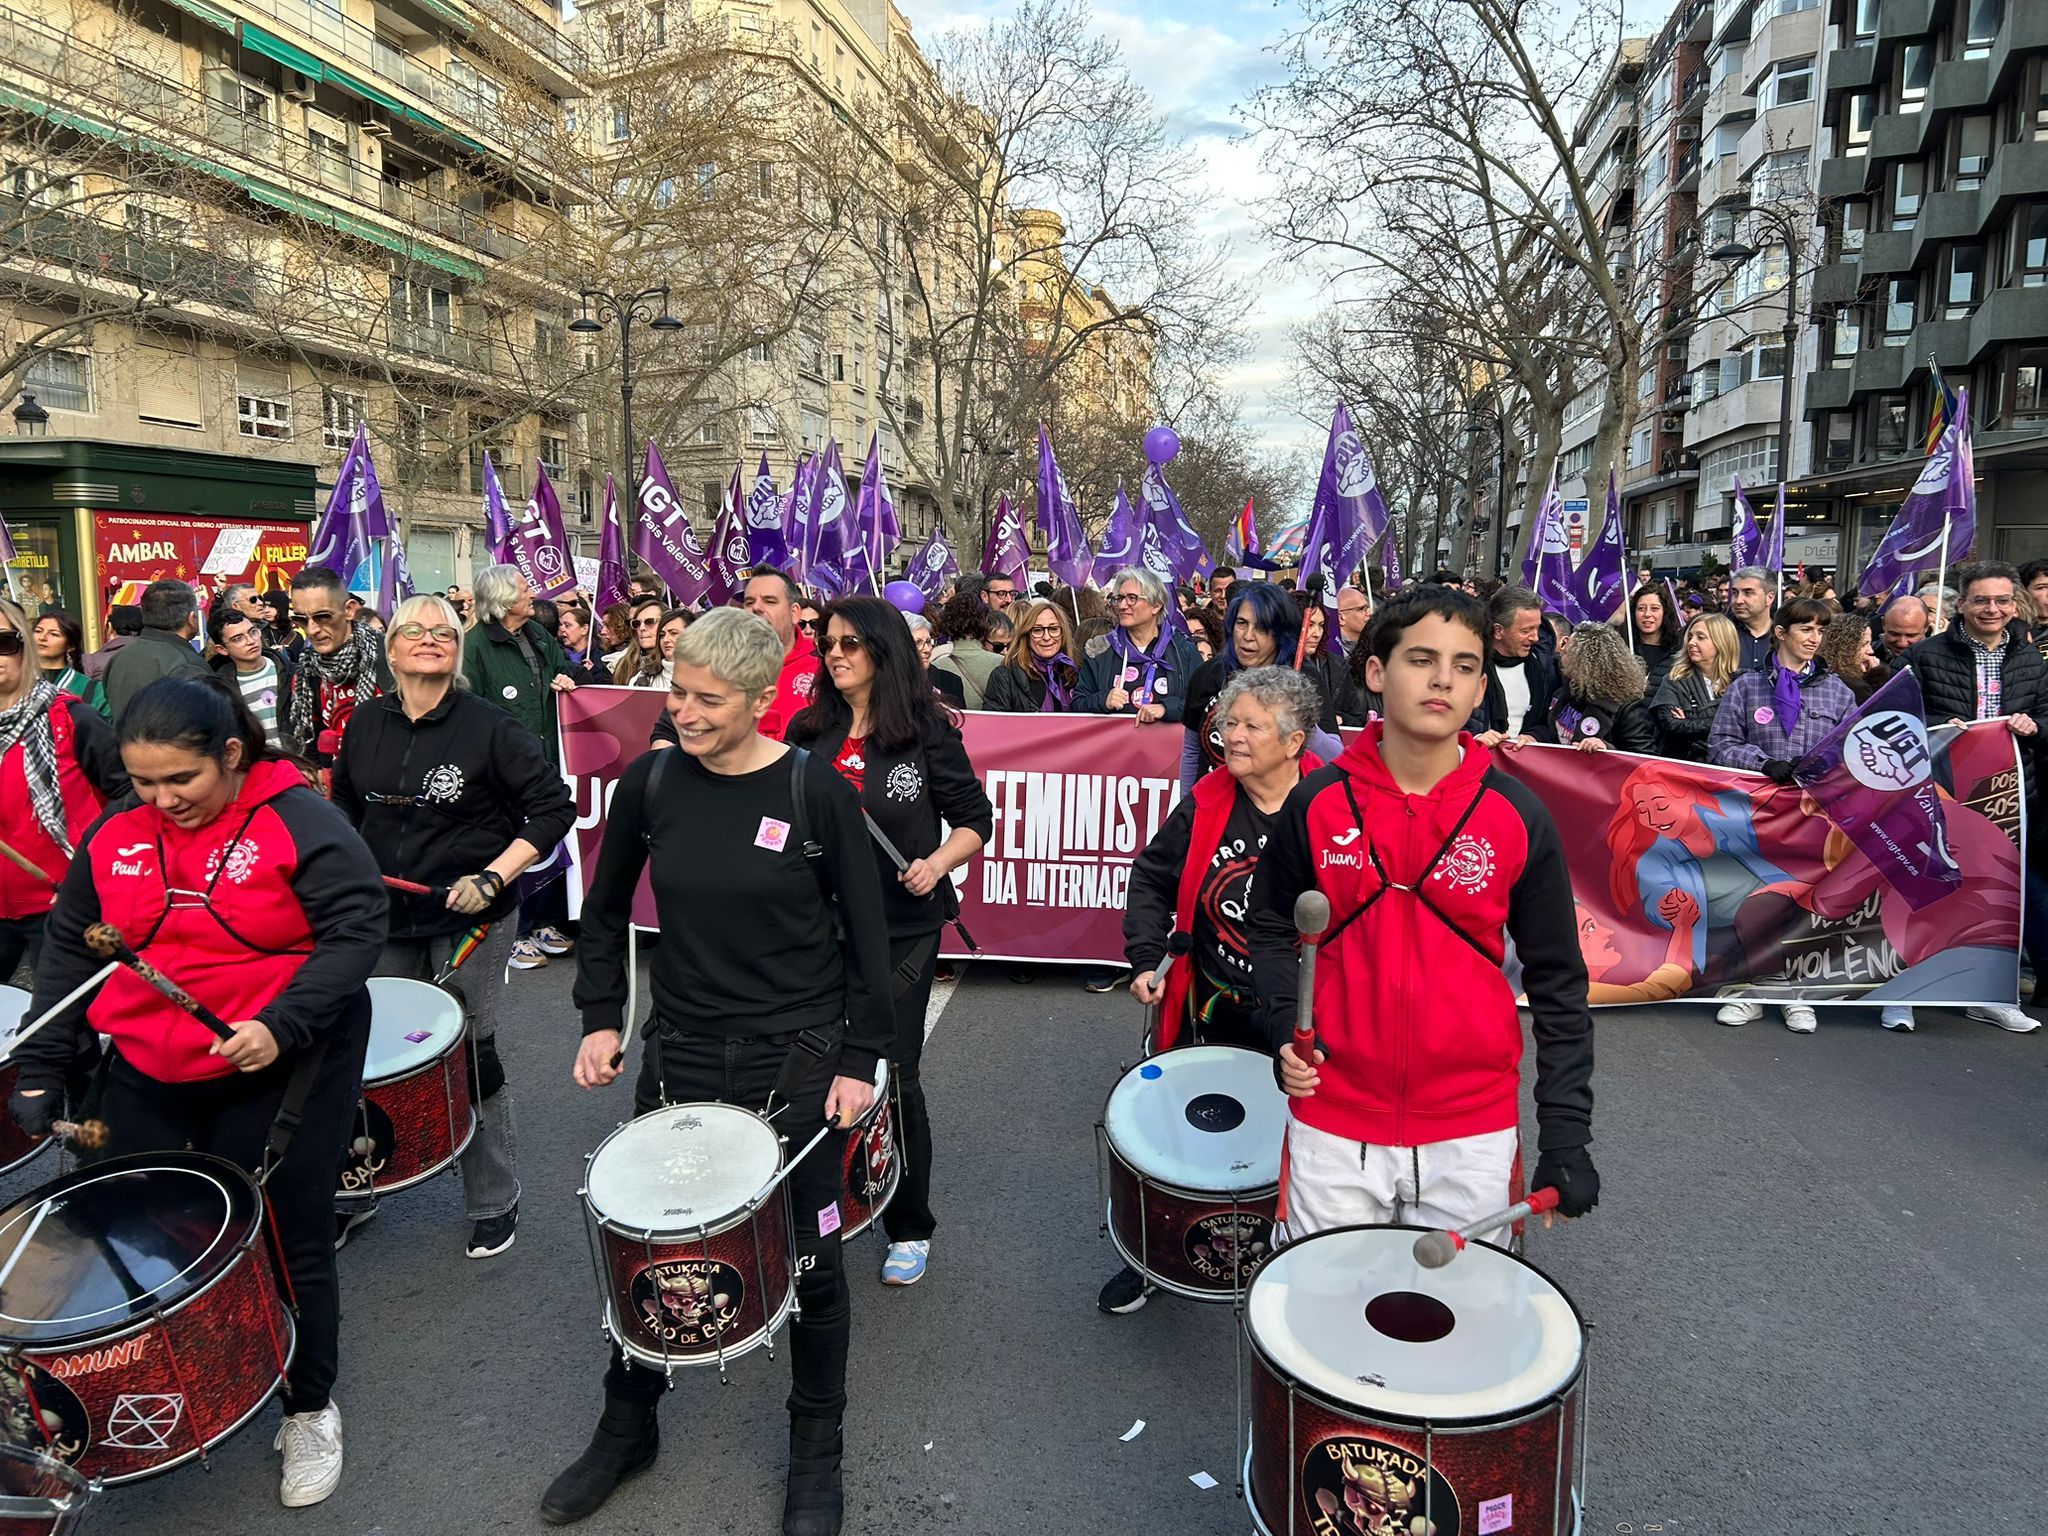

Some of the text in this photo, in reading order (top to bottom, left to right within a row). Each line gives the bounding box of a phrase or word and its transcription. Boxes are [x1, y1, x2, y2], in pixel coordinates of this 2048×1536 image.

[108, 517, 156, 526] PATROCINADOR
[157, 519, 180, 527] OFICIAL
[180, 520, 191, 528] DEL
[107, 541, 179, 563] AMBAR
[266, 545, 307, 563] FALLER
[640, 512, 705, 581] País Valencià
[1871, 714, 1929, 773] UGT
[1869, 821, 1920, 878] www.ugt-pv.es
[982, 861, 1018, 905] DIA
[341, 1157, 386, 1190] BAC
[644, 1263, 720, 1280] BATUKADA
[1193, 1255, 1221, 1277] TRO
[644, 1306, 737, 1344] TRO DE BAC
[49, 1332, 152, 1378] AMUNT
[1325, 1443, 1428, 1483] BATUKADA
